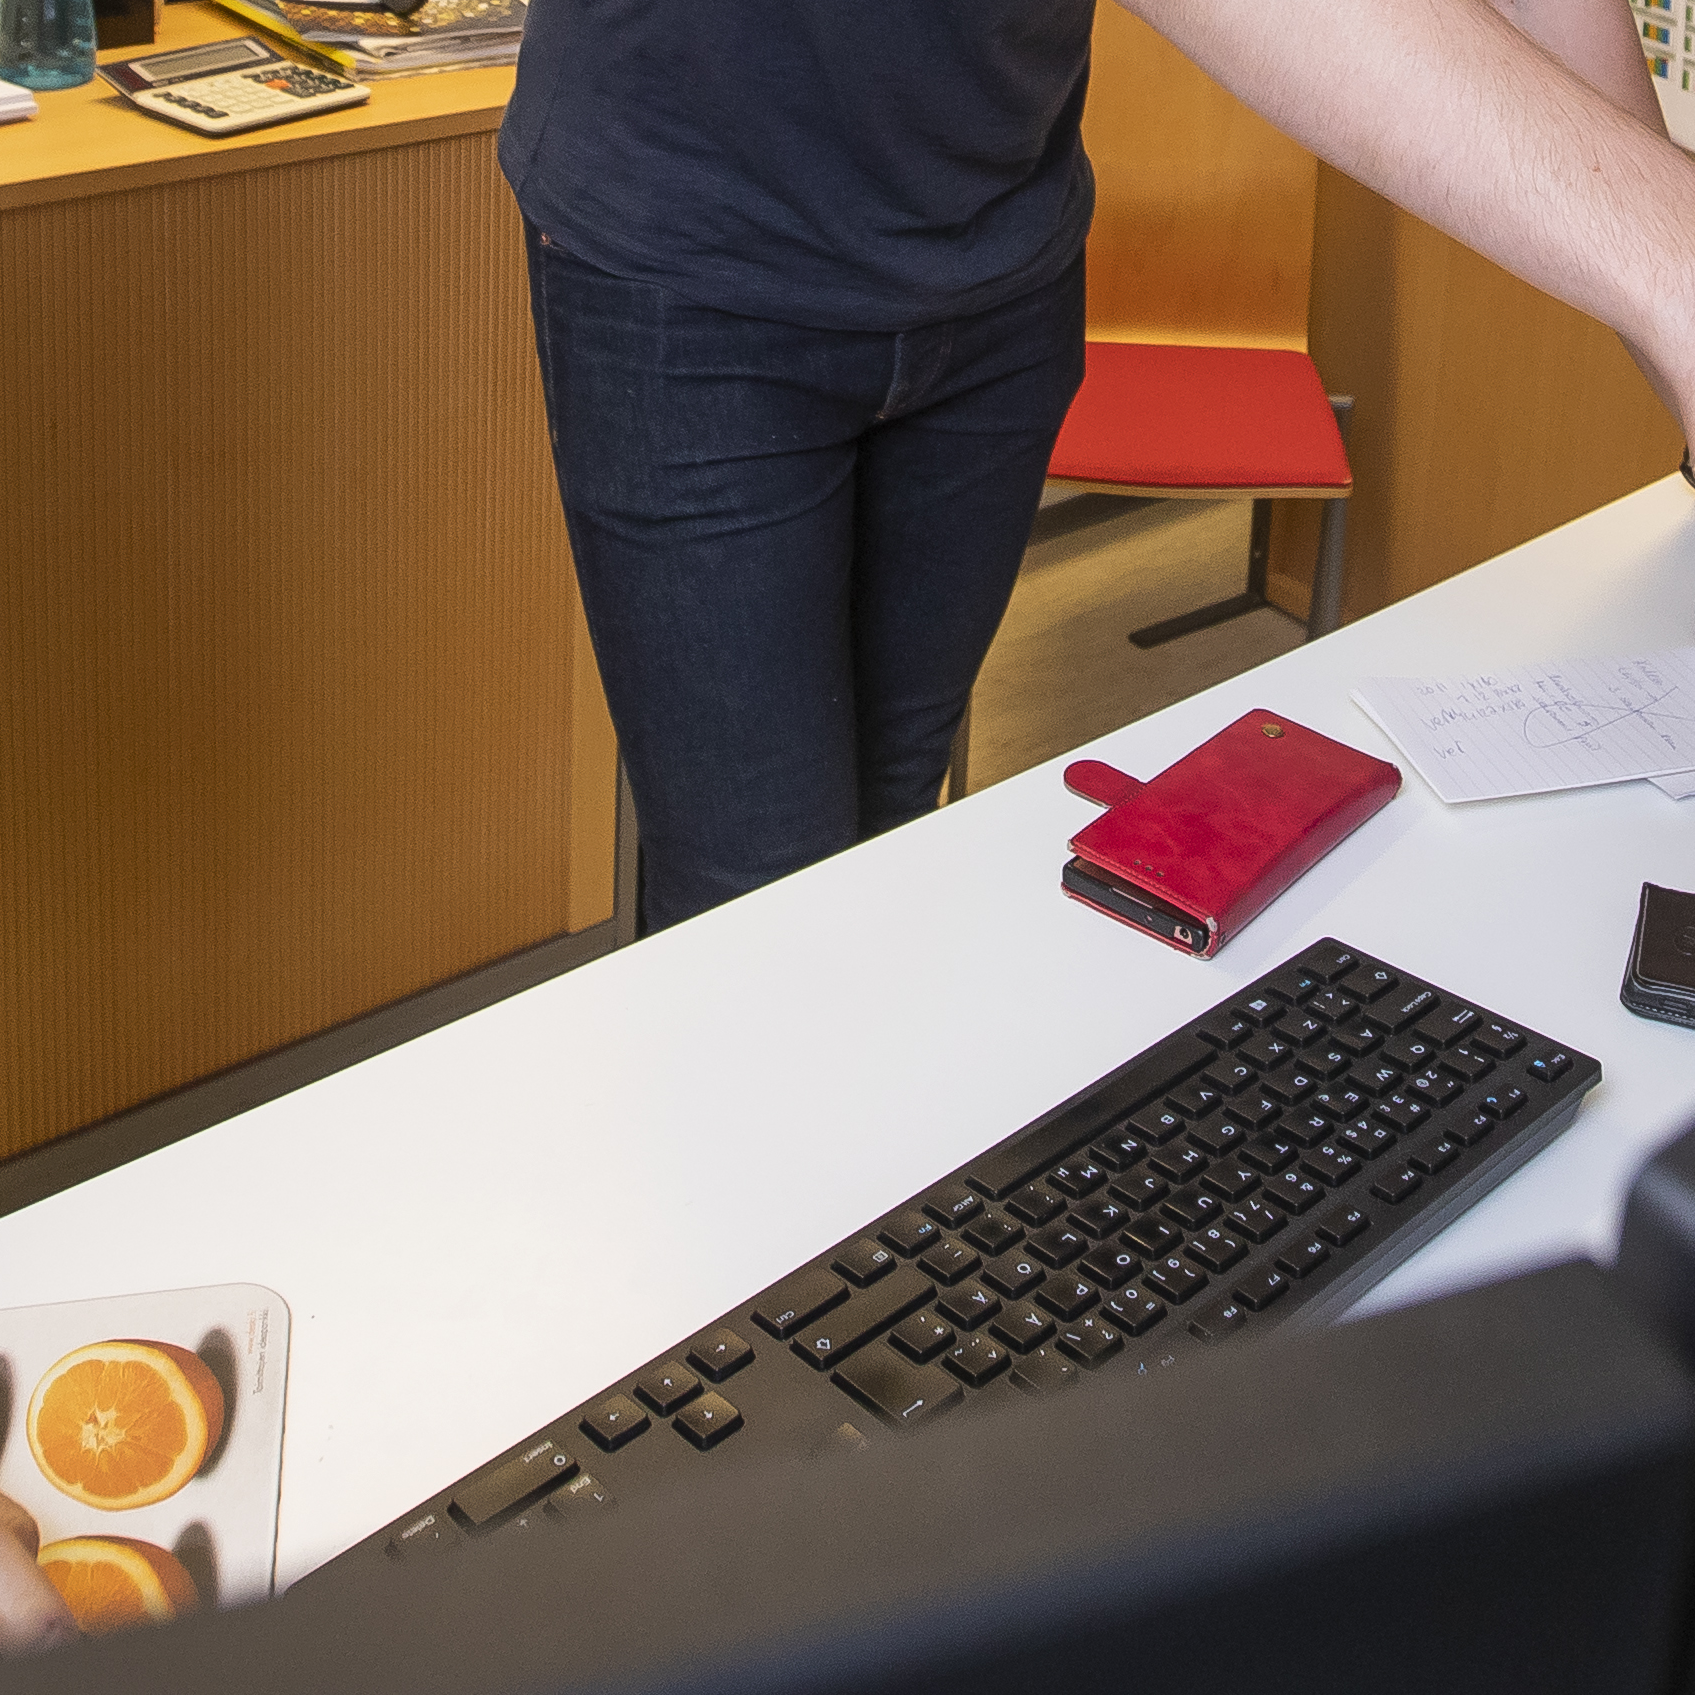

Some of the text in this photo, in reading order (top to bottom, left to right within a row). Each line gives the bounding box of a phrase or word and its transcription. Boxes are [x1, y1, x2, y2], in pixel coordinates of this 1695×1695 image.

[1302, 1019, 1318, 1031] Z
[1359, 1028, 1374, 1039] A
[1268, 1042, 1285, 1054] X
[1409, 1044, 1426, 1055] Q
[1458, 1048, 1469, 1056] 1
[1327, 1052, 1343, 1063] S
[1233, 1066, 1248, 1076] C
[1375, 1068, 1394, 1082] W
[1425, 1069, 1438, 1081] 2
[1293, 1075, 1309, 1087] D
[1199, 1090, 1214, 1101] V
[1343, 1091, 1360, 1103] E
[1391, 1094, 1405, 1105] 3
[1261, 1099, 1273, 1111] F
[1160, 1113, 1176, 1125] B
[1308, 1116, 1325, 1128] R
[1356, 1120, 1368, 1130] 4
[1220, 1125, 1236, 1136] G
[1120, 1138, 1138, 1152] N
[1274, 1143, 1290, 1155] T
[1321, 1145, 1335, 1156] 5
[1182, 1149, 1199, 1163] H
[1080, 1164, 1099, 1180] M
[1237, 1170, 1252, 1182] Y
[1284, 1172, 1298, 1183] 6
[1144, 1177, 1155, 1189] J
[1196, 1196, 1214, 1209] U
[1249, 1200, 1261, 1211] 7
[1102, 1204, 1120, 1218] K
[1061, 1232, 1078, 1242] L
[1207, 1228, 1221, 1240] 8
[1115, 1253, 1132, 1266] O
[1166, 1257, 1181, 1269] 9
[1075, 1283, 1089, 1296] P
[1125, 1288, 1138, 1300] 0
[553, 1455, 566, 1466] 0
[593, 1493, 603, 1502] 1
